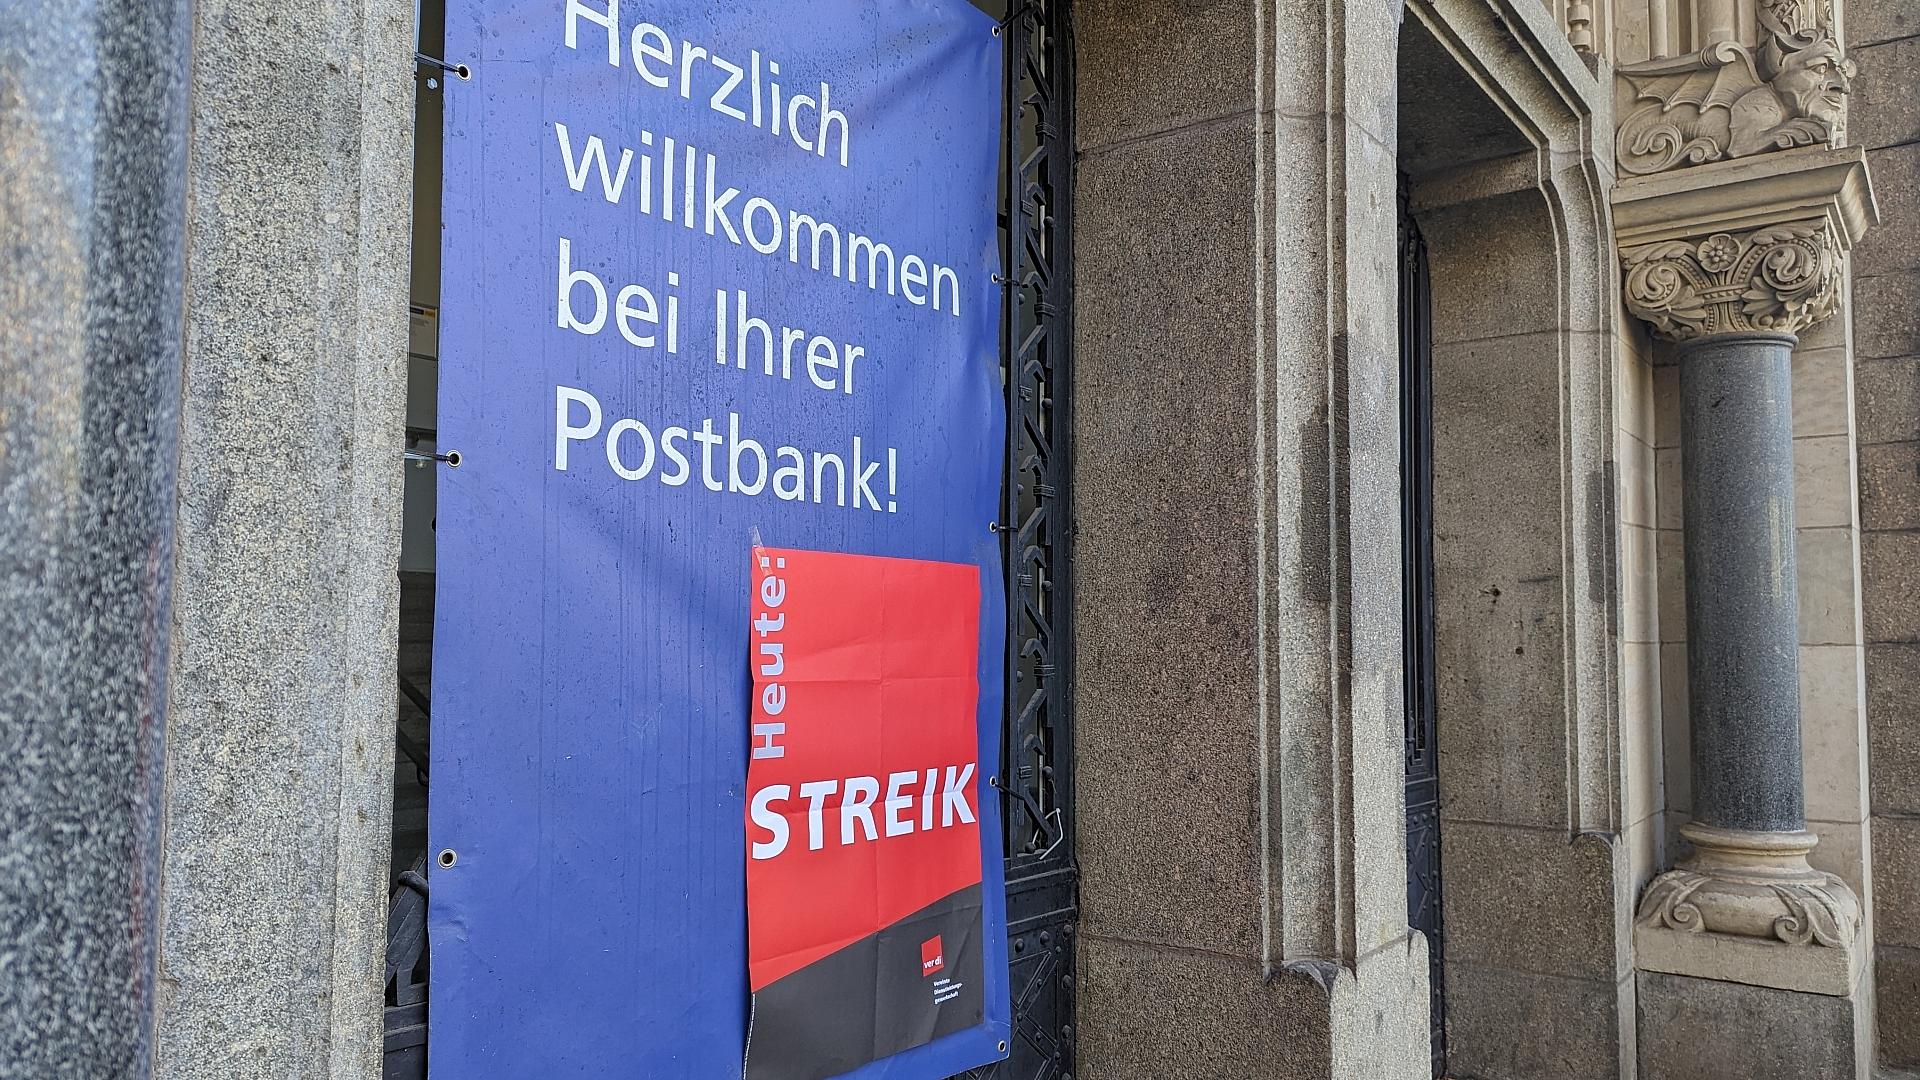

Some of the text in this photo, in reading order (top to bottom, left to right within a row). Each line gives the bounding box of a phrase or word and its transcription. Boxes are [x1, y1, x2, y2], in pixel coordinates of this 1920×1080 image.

[565, 0, 849, 168] Herzlich
[555, 121, 960, 317] willkommen
[557, 237, 865, 395] bei Ihrer
[555, 385, 897, 513] Postbank!
[752, 556, 786, 760] Heute:
[750, 762, 977, 860] STREIK
